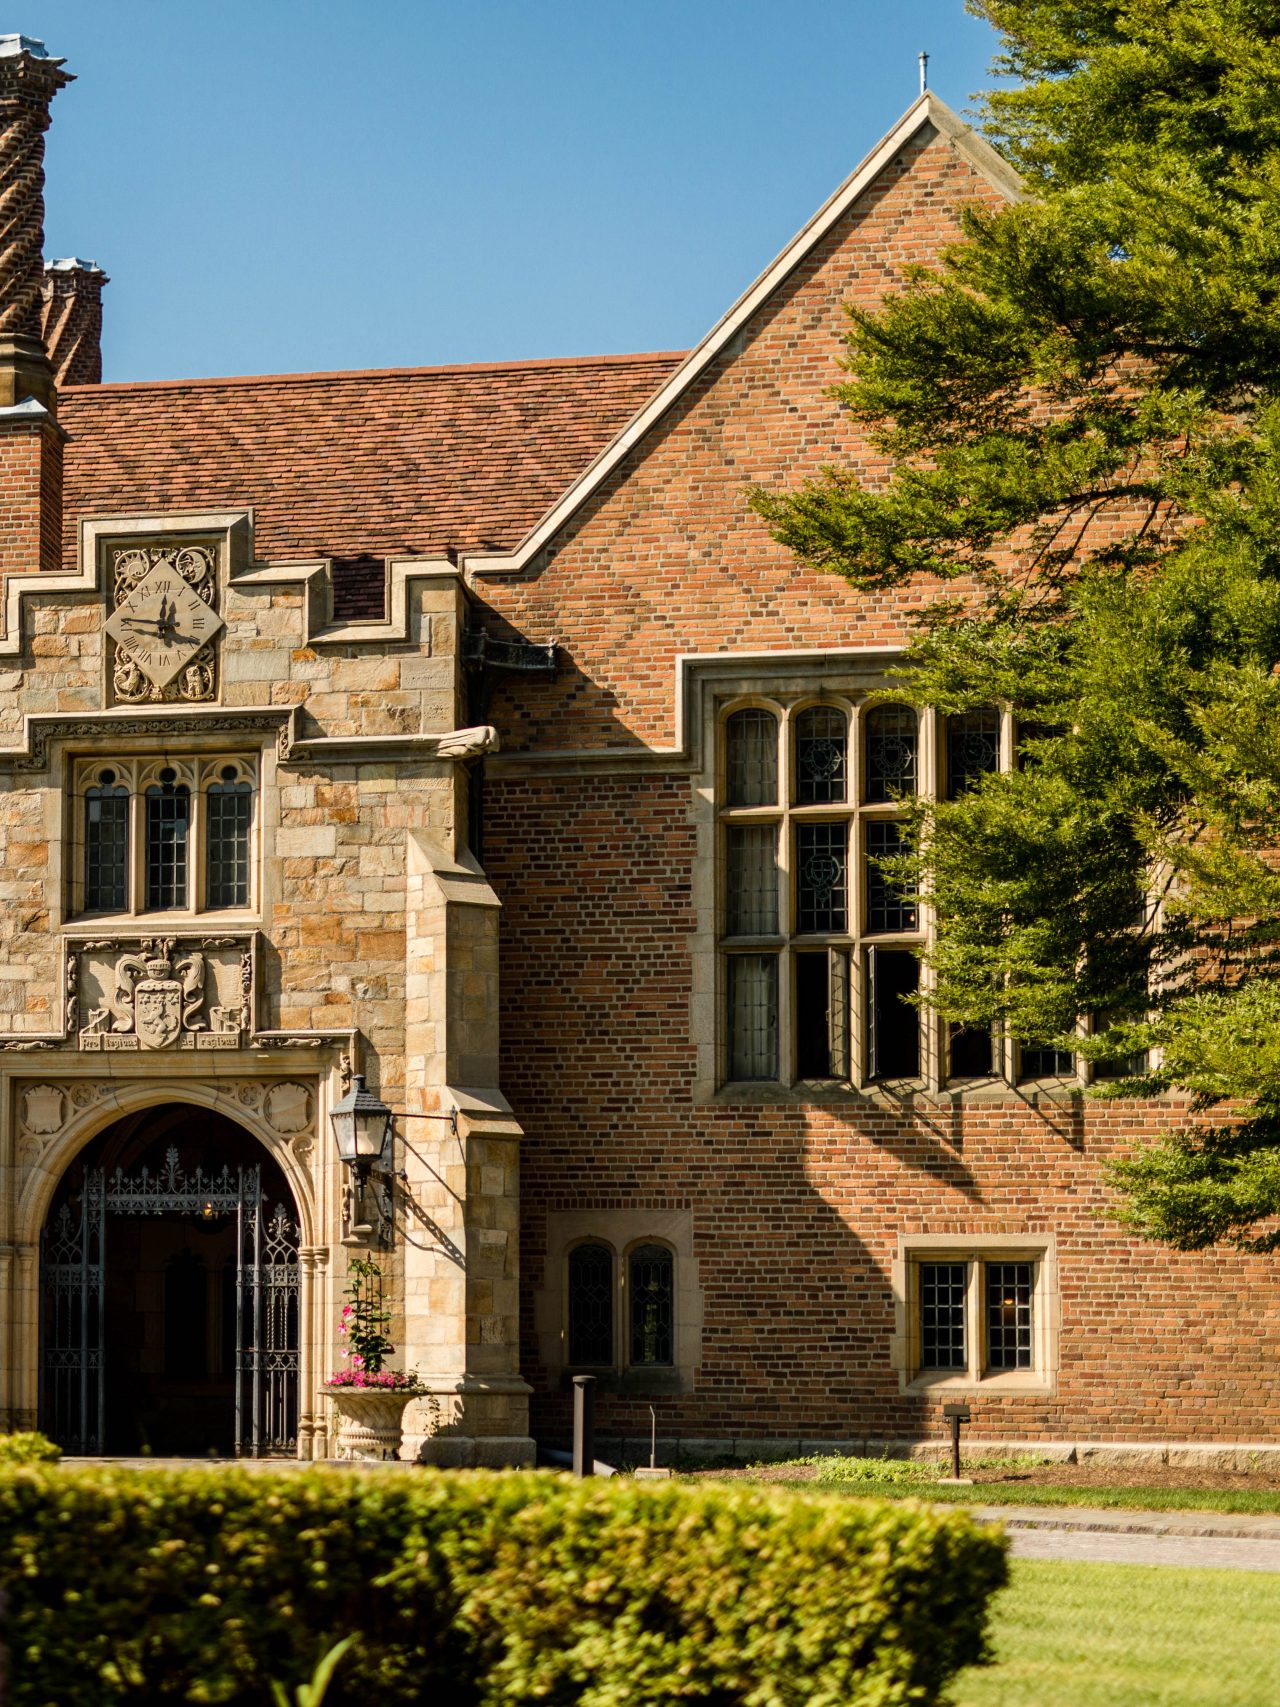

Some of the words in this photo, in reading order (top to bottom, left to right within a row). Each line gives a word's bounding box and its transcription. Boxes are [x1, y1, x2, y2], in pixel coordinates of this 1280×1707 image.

[137, 586, 151, 601] XI
[155, 581, 171, 594] XII
[177, 586, 186, 597] I
[126, 601, 139, 614] X
[188, 600, 200, 611] II
[192, 618, 205, 629] III
[123, 636, 139, 653] VIII
[137, 650, 152, 665] VII
[159, 654, 171, 666] VI
[177, 649, 187, 661] V
